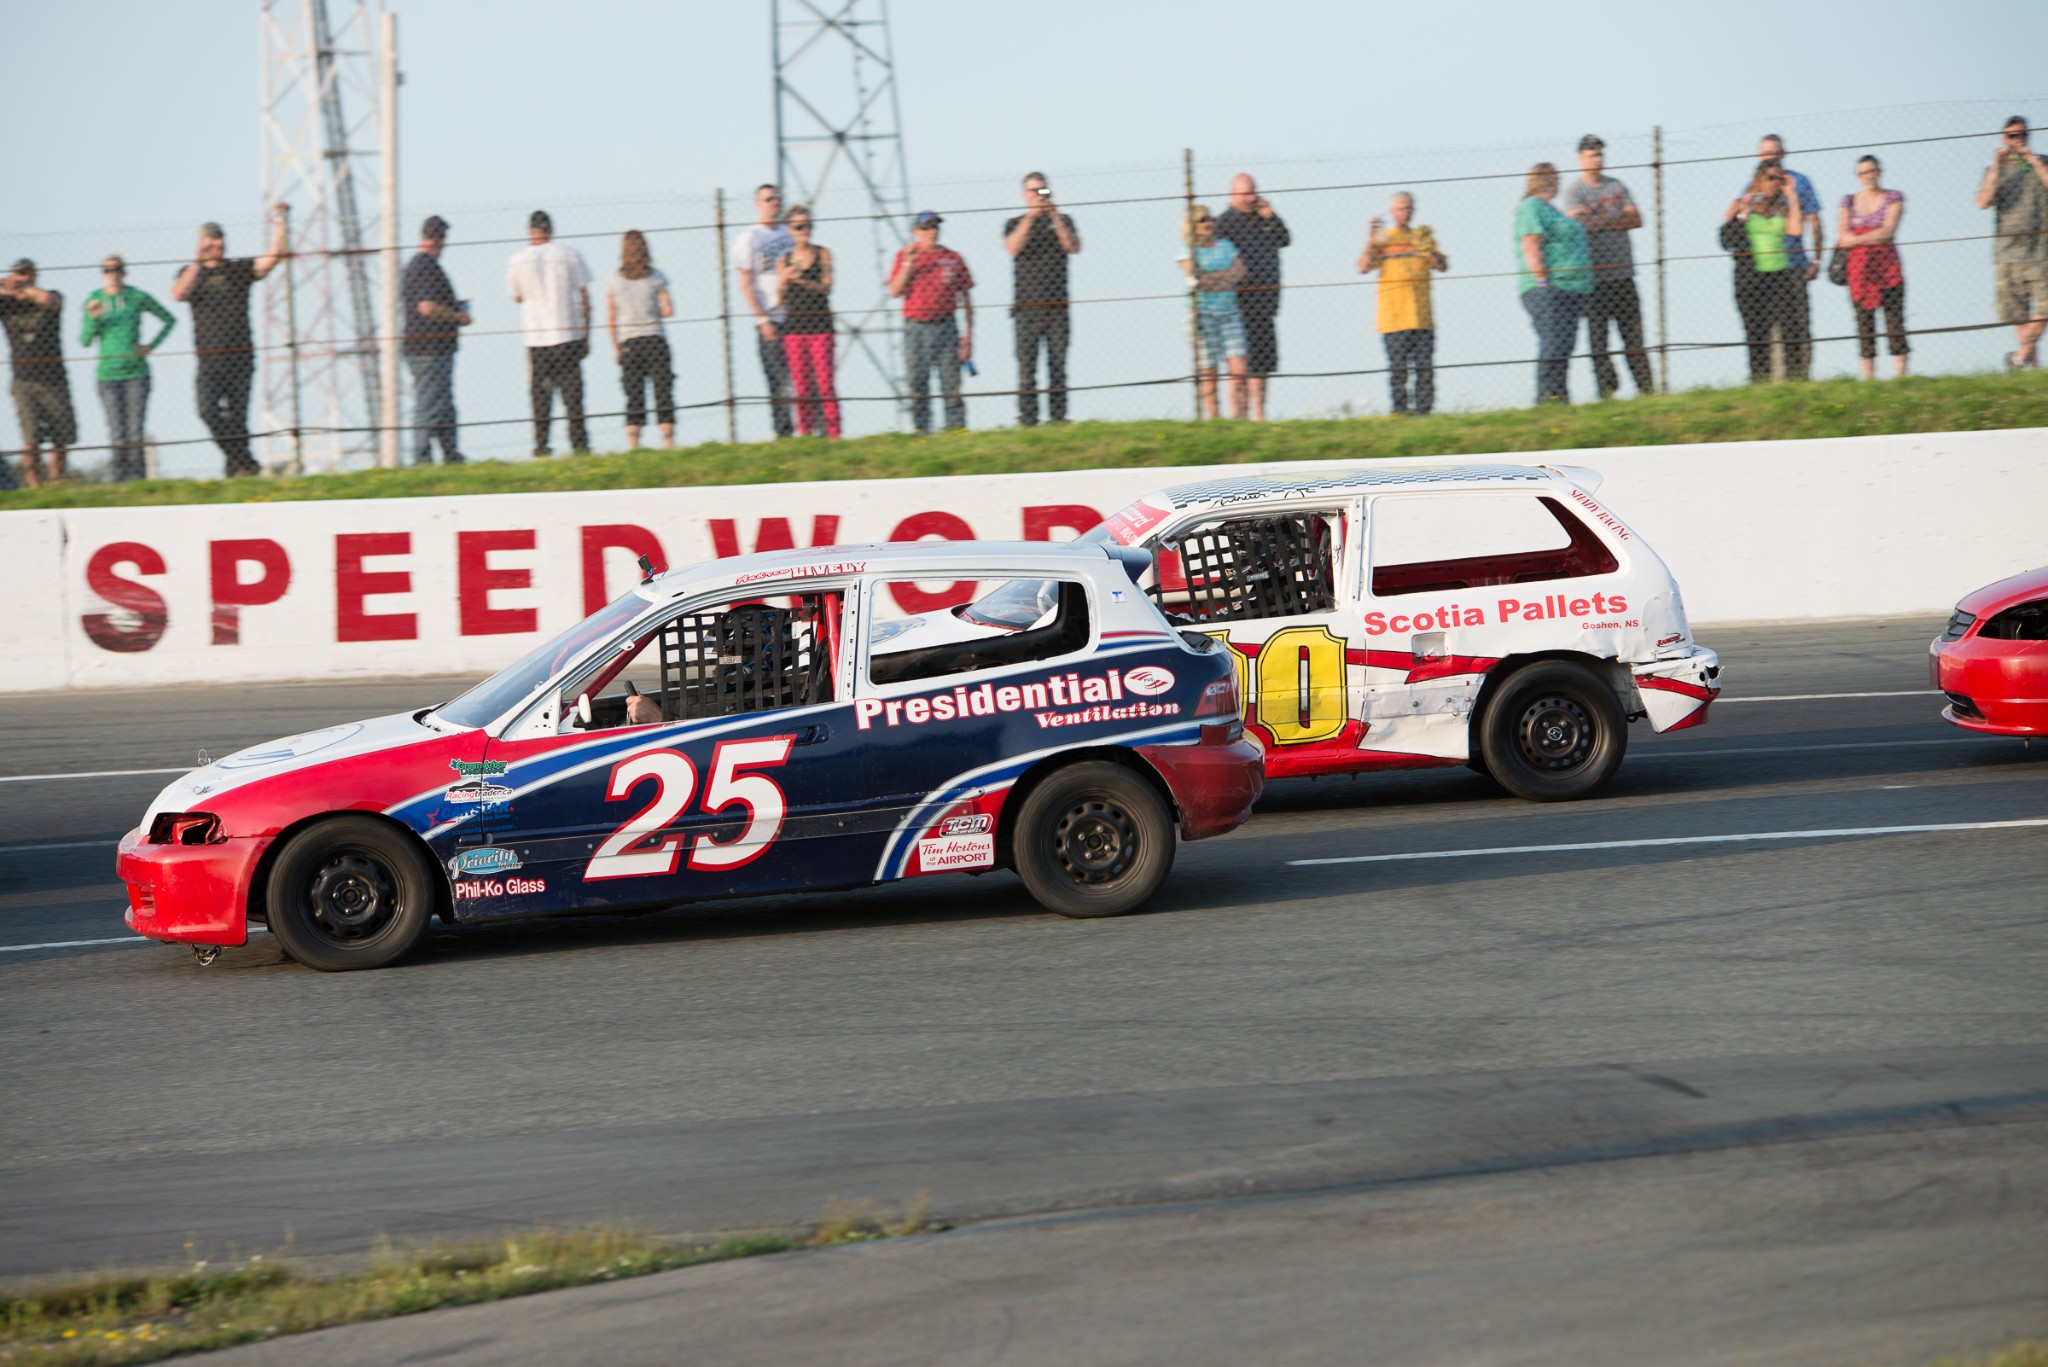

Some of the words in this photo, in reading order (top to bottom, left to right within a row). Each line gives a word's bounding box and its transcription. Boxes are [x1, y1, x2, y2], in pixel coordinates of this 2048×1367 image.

[1596, 512, 1631, 540] RACING
[791, 562, 866, 578] LIVELY
[1364, 603, 1485, 636] Scotia
[1498, 592, 1628, 623] Pallets
[1582, 622, 1622, 631] Goshen,
[1625, 619, 1639, 629] NS
[854, 667, 1123, 731] Presidential
[1034, 702, 1181, 730] Ventilation
[457, 761, 482, 771] Green
[483, 760, 508, 769] Arbor
[582, 734, 797, 883] 25
[946, 816, 988, 831] TCM
[922, 843, 943, 855] Tim
[946, 841, 990, 853] Hortons
[937, 853, 987, 865] AIRPORT
[448, 849, 516, 880] Priority
[455, 880, 504, 899] Phil-Ko
[505, 877, 546, 895] Glass
